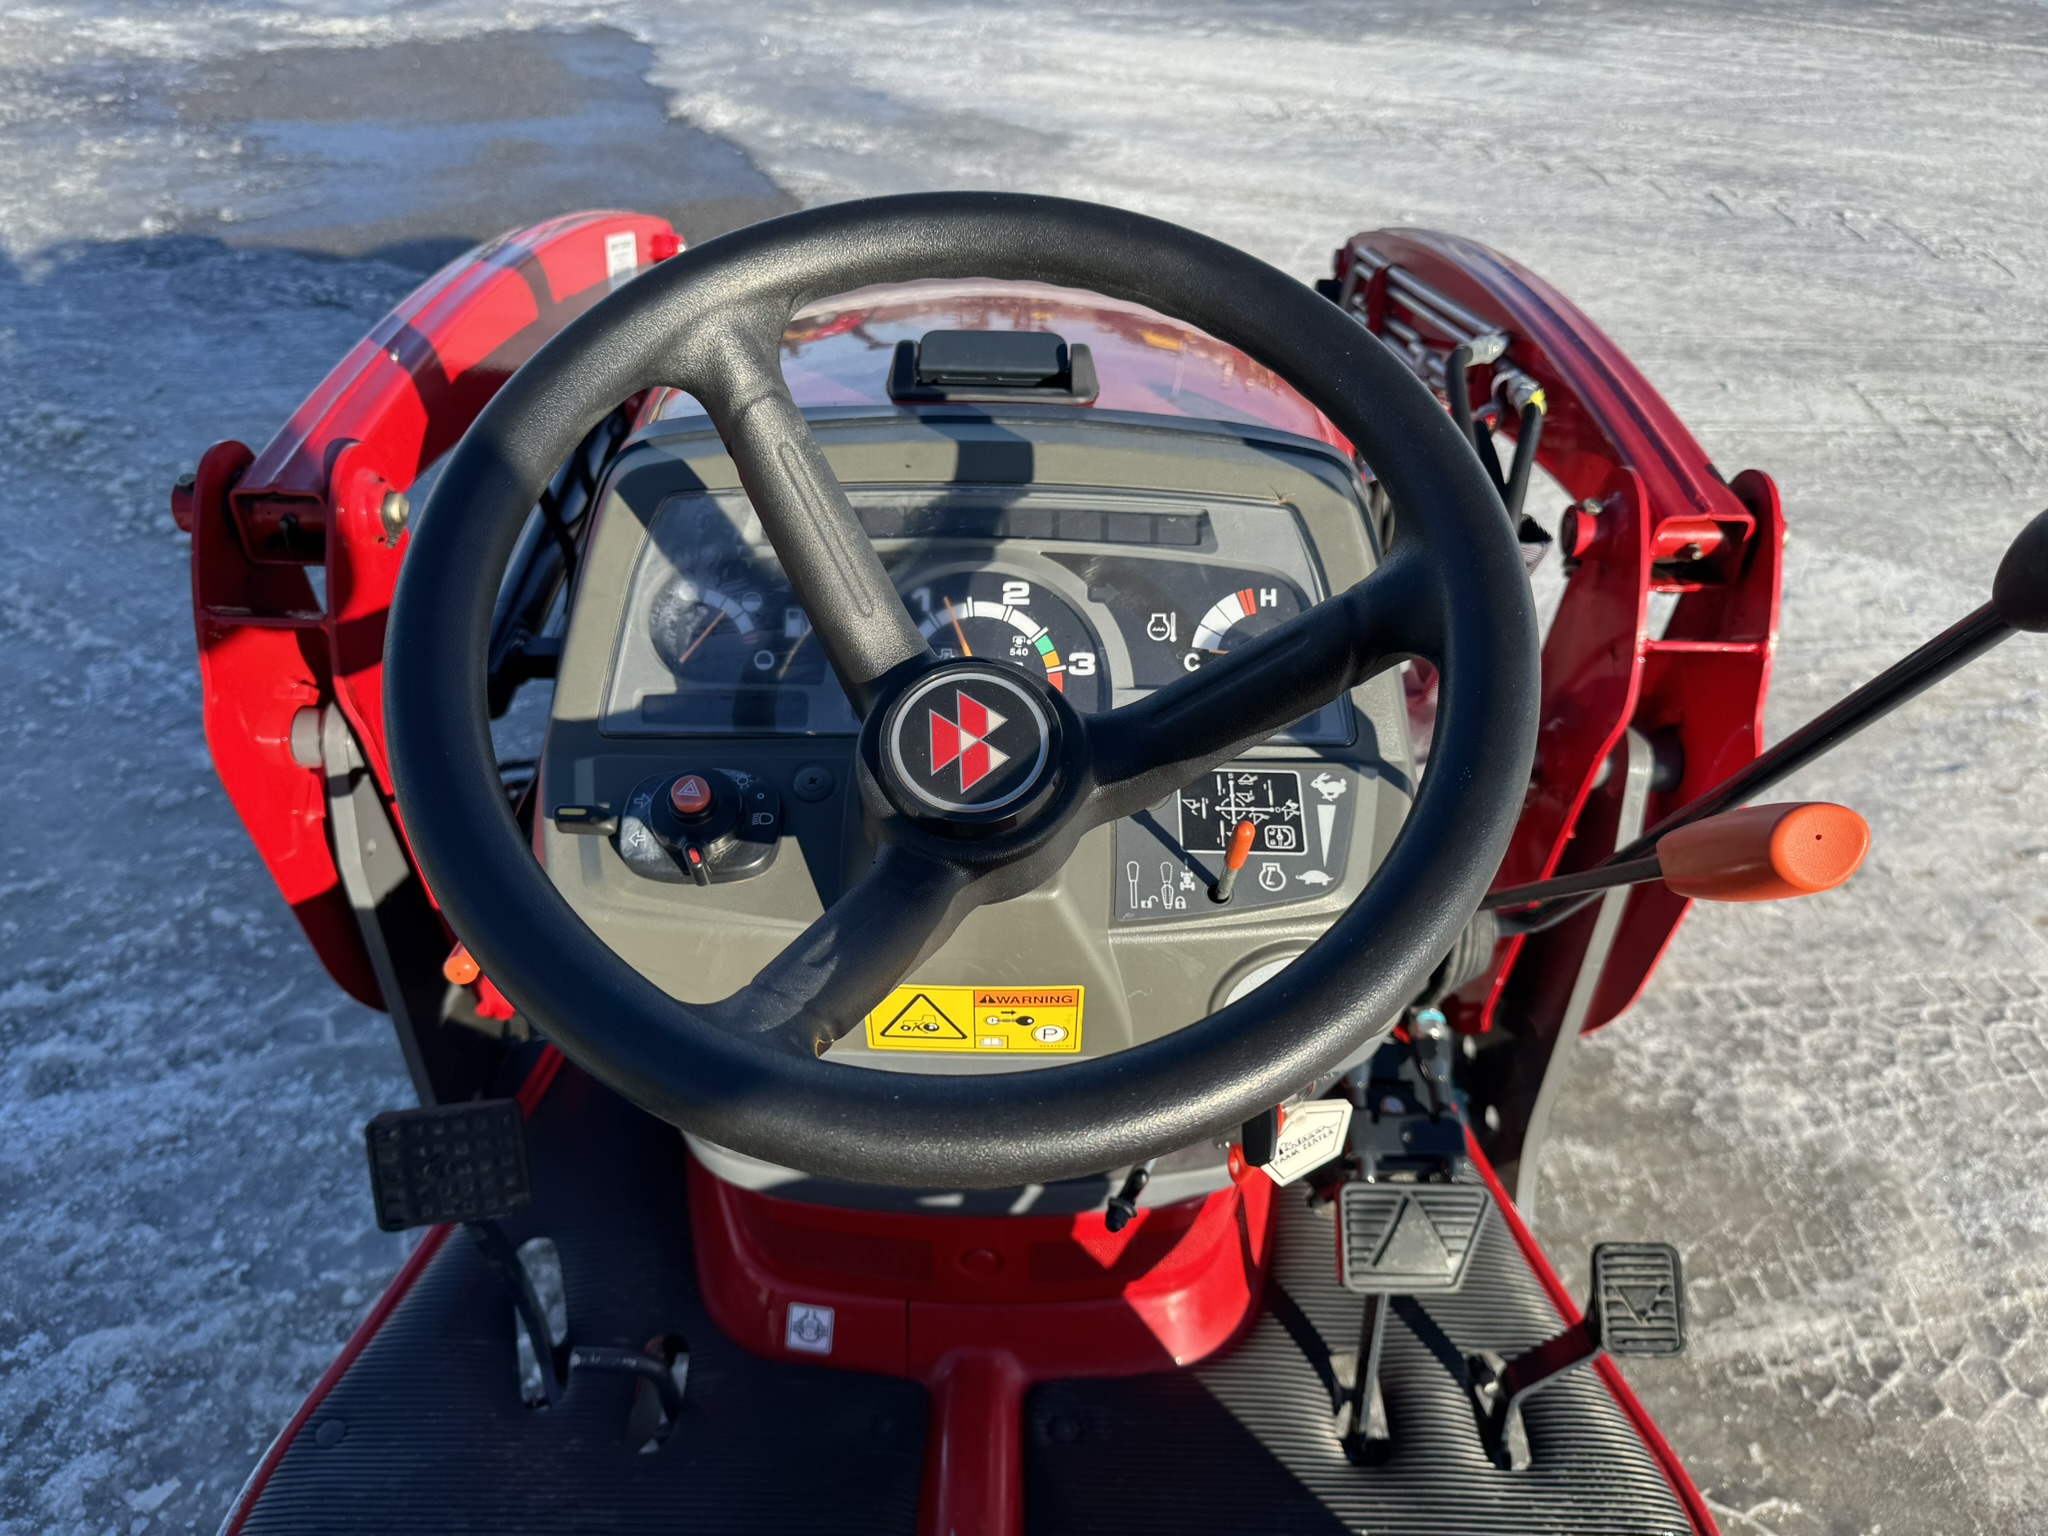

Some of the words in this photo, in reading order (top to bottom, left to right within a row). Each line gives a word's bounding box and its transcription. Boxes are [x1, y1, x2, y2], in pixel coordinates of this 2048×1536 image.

[911, 587, 931, 612] 1
[1002, 581, 1031, 606] 2
[1260, 588, 1277, 607] H
[1009, 647, 1029, 656] 540
[1068, 651, 1096, 676] 3
[1183, 652, 1201, 672] C
[996, 994, 1073, 1004] WARNING
[1043, 1027, 1058, 1040] P
